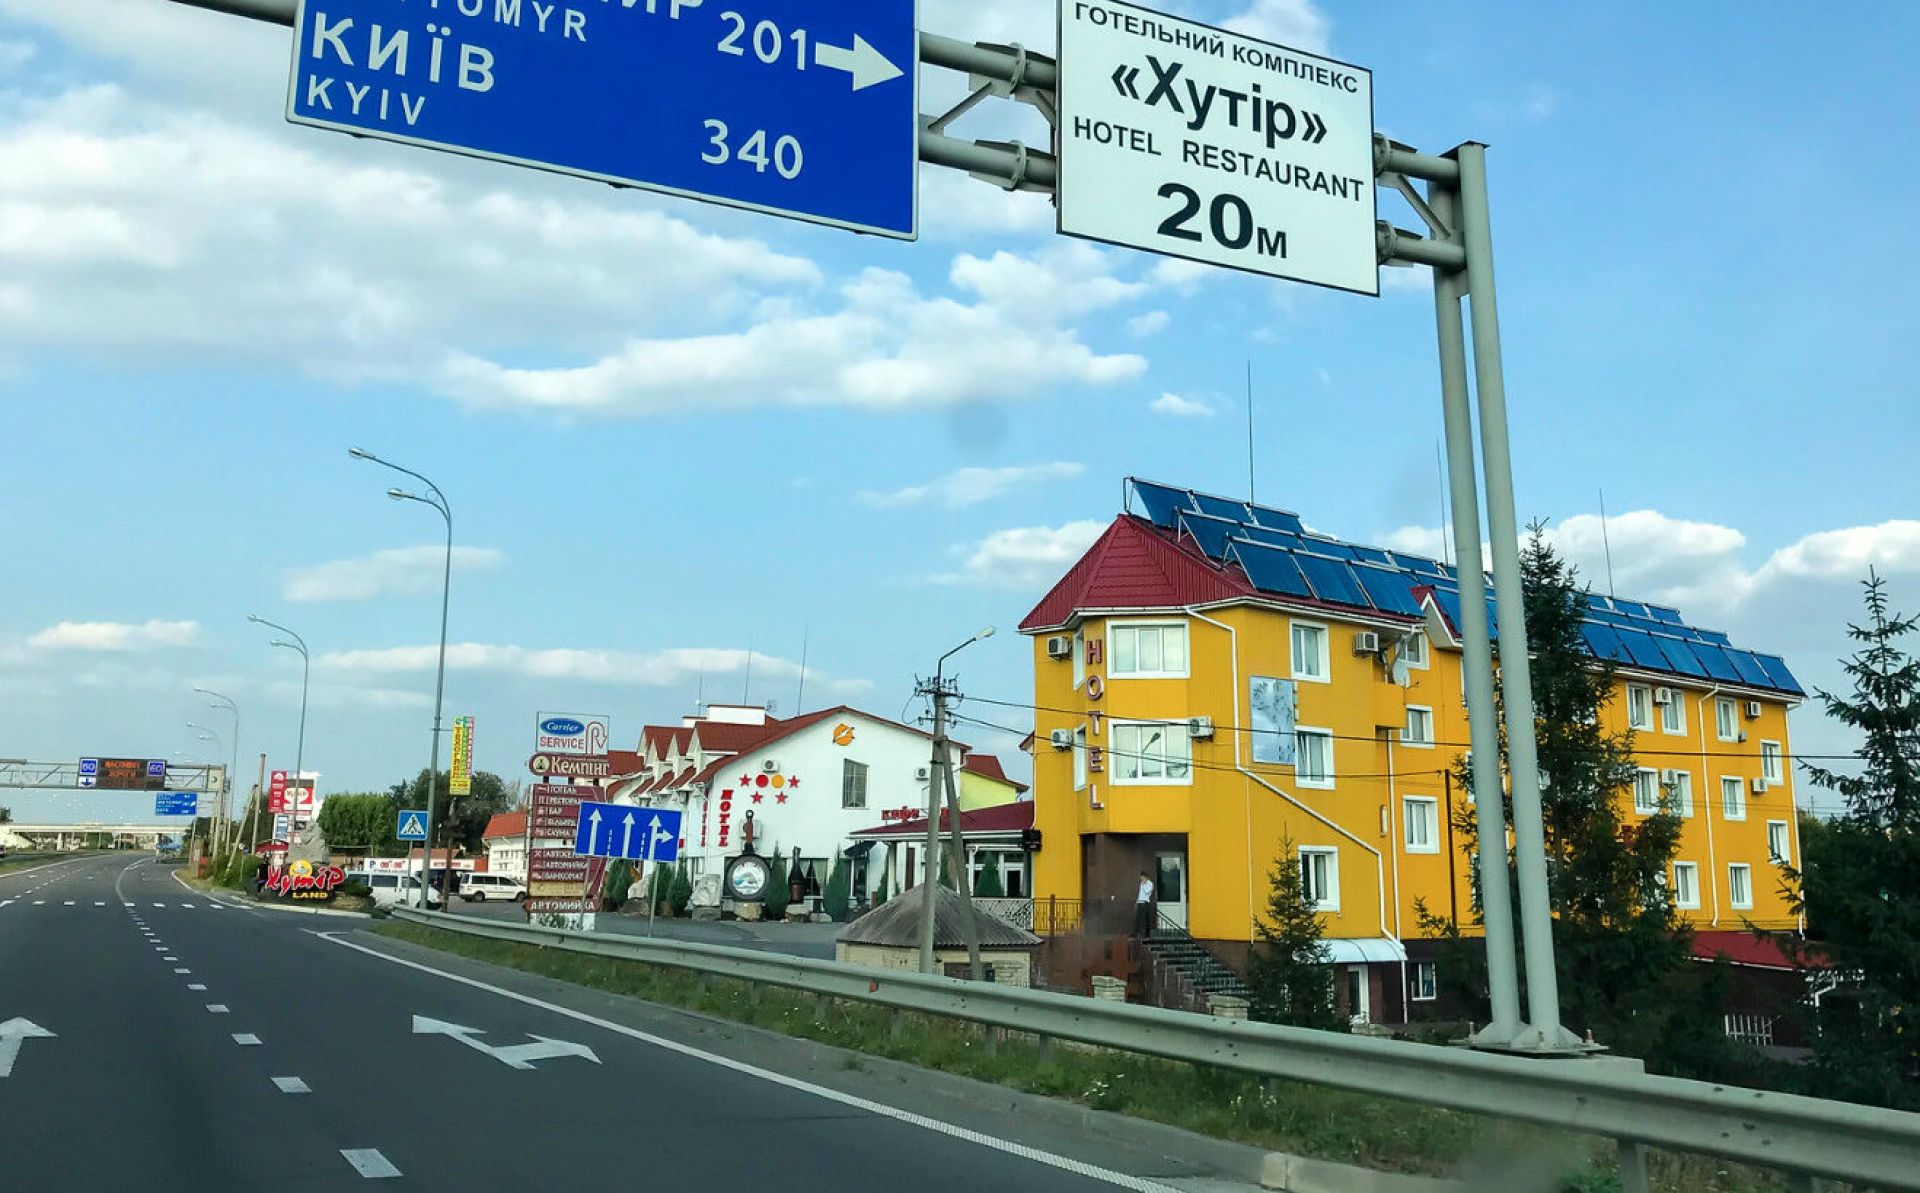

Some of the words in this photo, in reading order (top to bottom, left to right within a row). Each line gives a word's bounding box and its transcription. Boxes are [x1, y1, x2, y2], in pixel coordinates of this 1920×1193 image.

[431, 0, 587, 41] OMYR
[717, 11, 807, 71] 201
[1075, 2, 1224, 58] ГОТЕЛЬНИЙ
[1233, 44, 1358, 94] КОМПЛЕКС
[312, 12, 495, 92] КИЇВ
[308, 75, 426, 126] KYIV
[1111, 54, 1328, 149] «Хутір»
[702, 119, 804, 180] 340
[1074, 116, 1162, 156] HOTEL
[1182, 140, 1364, 202] RESTAURANT
[540, 736, 585, 750] SERVICE
[546, 721, 579, 733] Carrier
[1086, 638, 1105, 811] HOTEL
[548, 807, 563, 815] БАР
[718, 789, 734, 847] HOTEL
[292, 891, 329, 899] LAND
